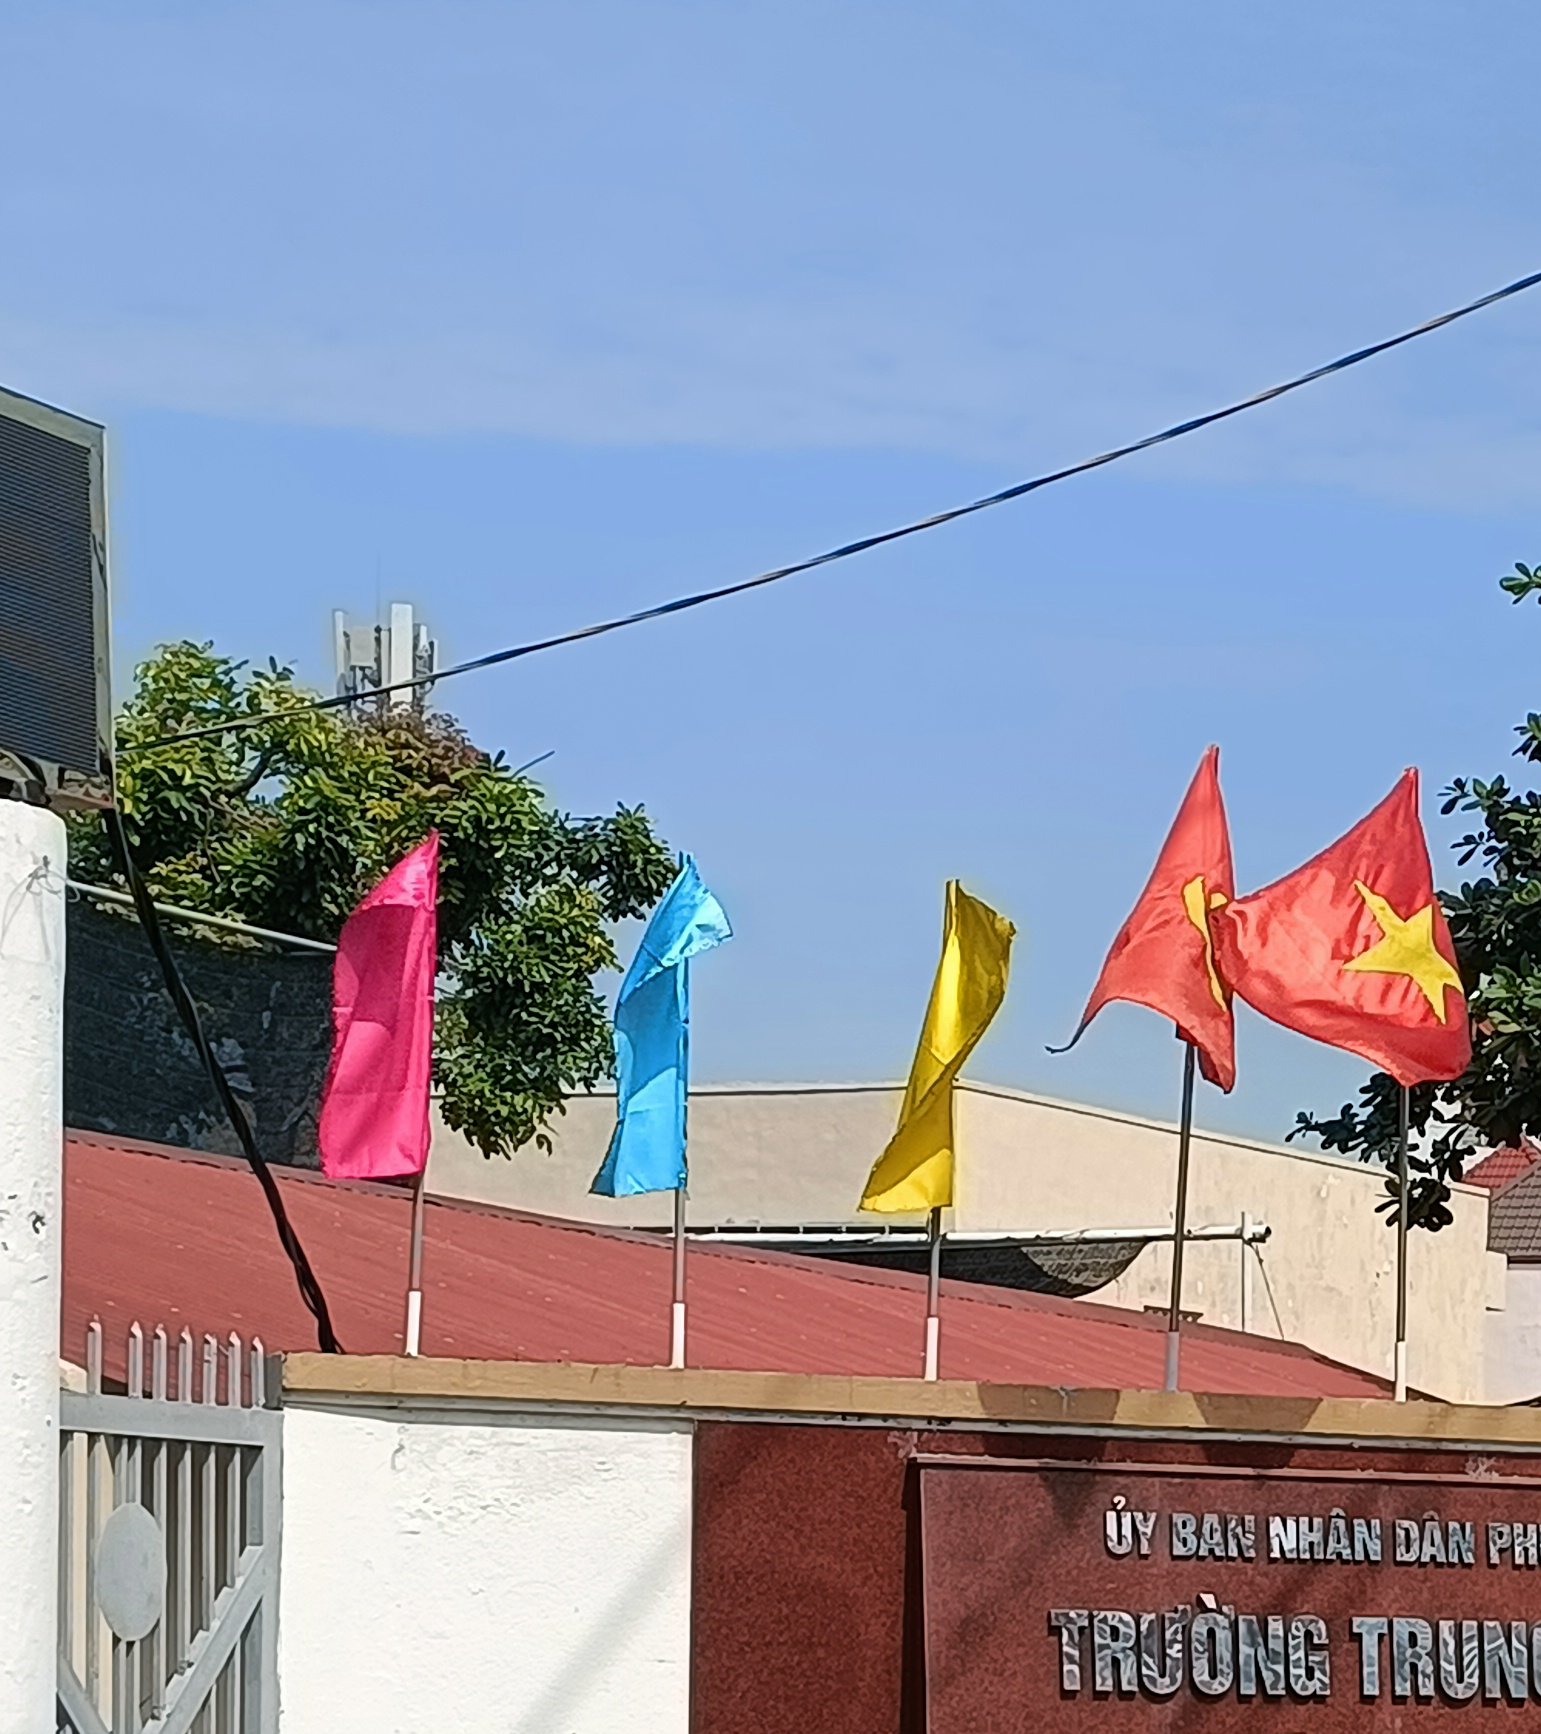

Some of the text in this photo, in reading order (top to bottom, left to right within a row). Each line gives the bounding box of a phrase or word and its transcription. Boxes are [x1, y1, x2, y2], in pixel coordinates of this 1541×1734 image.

[1105, 1495, 1158, 1556] ỦY
[1171, 1512, 1257, 1559] BAN
[1267, 1507, 1383, 1562] NHÂN
[1393, 1509, 1476, 1565] DÂN
[1050, 1592, 1331, 1697] TRƯỜNG
